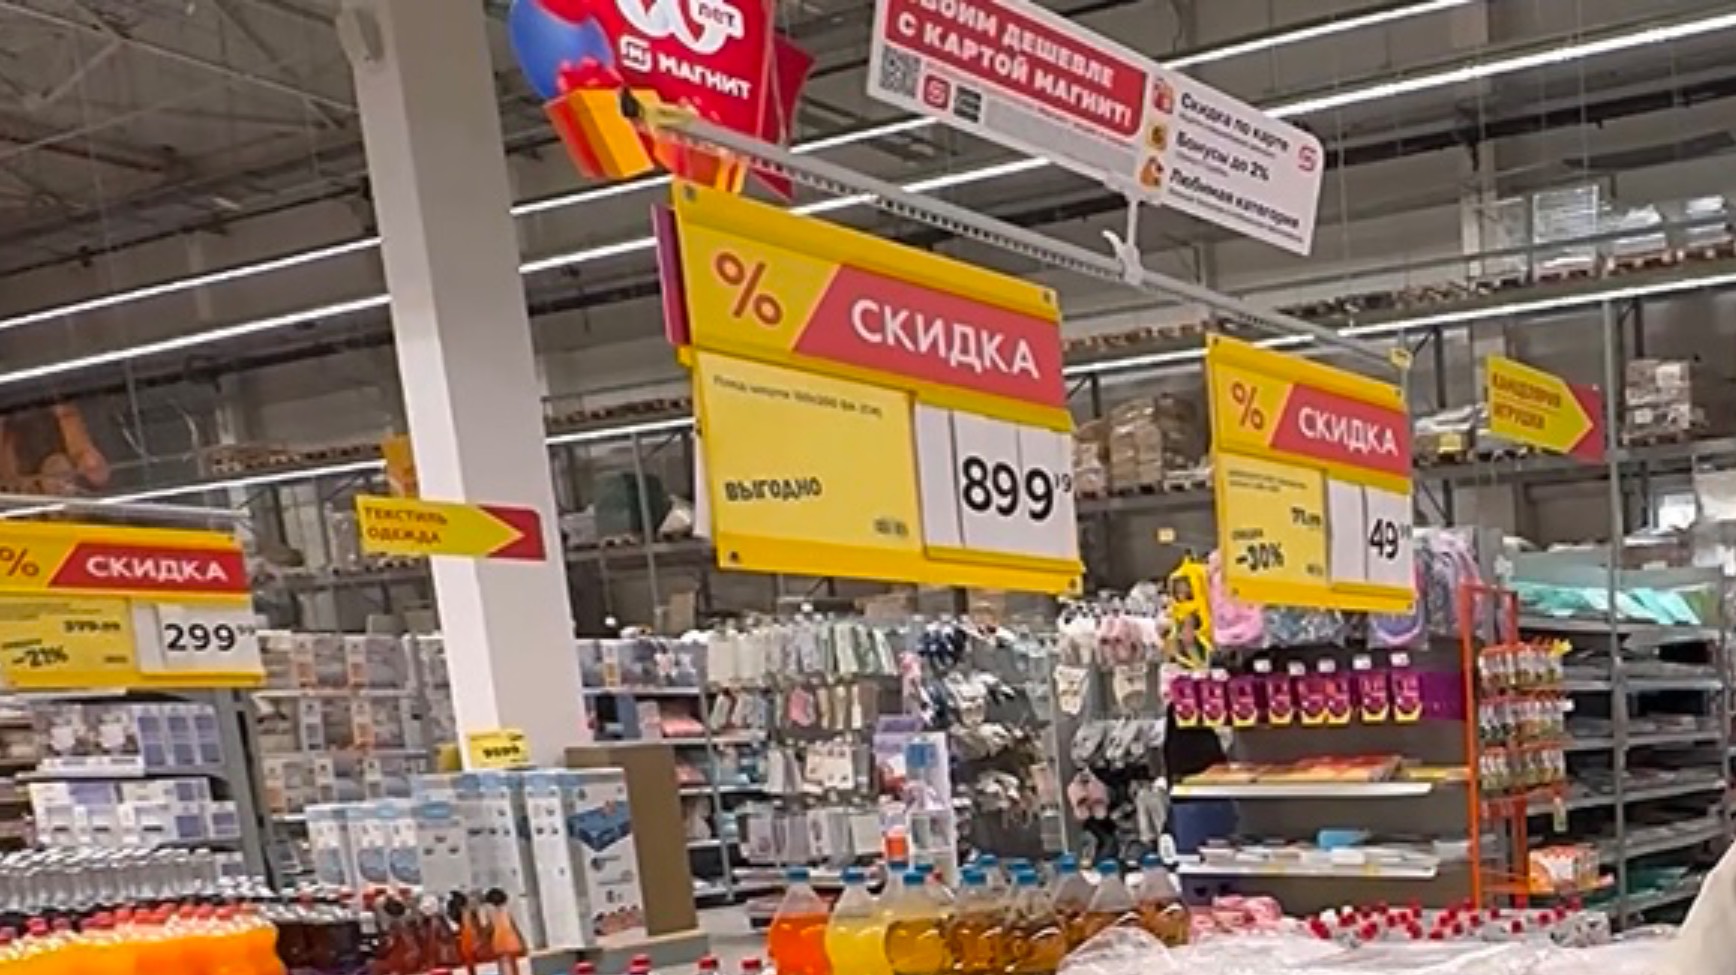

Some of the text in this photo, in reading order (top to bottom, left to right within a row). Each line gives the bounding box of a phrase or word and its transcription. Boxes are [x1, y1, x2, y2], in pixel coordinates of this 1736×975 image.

[656, 53, 752, 99] МАГНИТ
[898, 11, 917, 37] С
[923, 22, 1029, 84] КАРТОЙ
[1033, 68, 1133, 127] МАГНИТ!
[1002, 23, 1115, 88] ДЕШЕВЛЕ
[1181, 92, 1231, 128] Скидка
[851, 299, 1040, 380] СКИДКА
[1298, 407, 1399, 457] СКИДКА
[724, 476, 823, 502] ВЫГОДНО
[961, 455, 1054, 522] 899
[364, 506, 448, 526] ТЕКСТИЛЬ
[367, 526, 442, 545] ОДЕЖДА
[1369, 517, 1400, 559] 49
[86, 556, 228, 583] СКИДКА
[164, 623, 236, 652] 299
